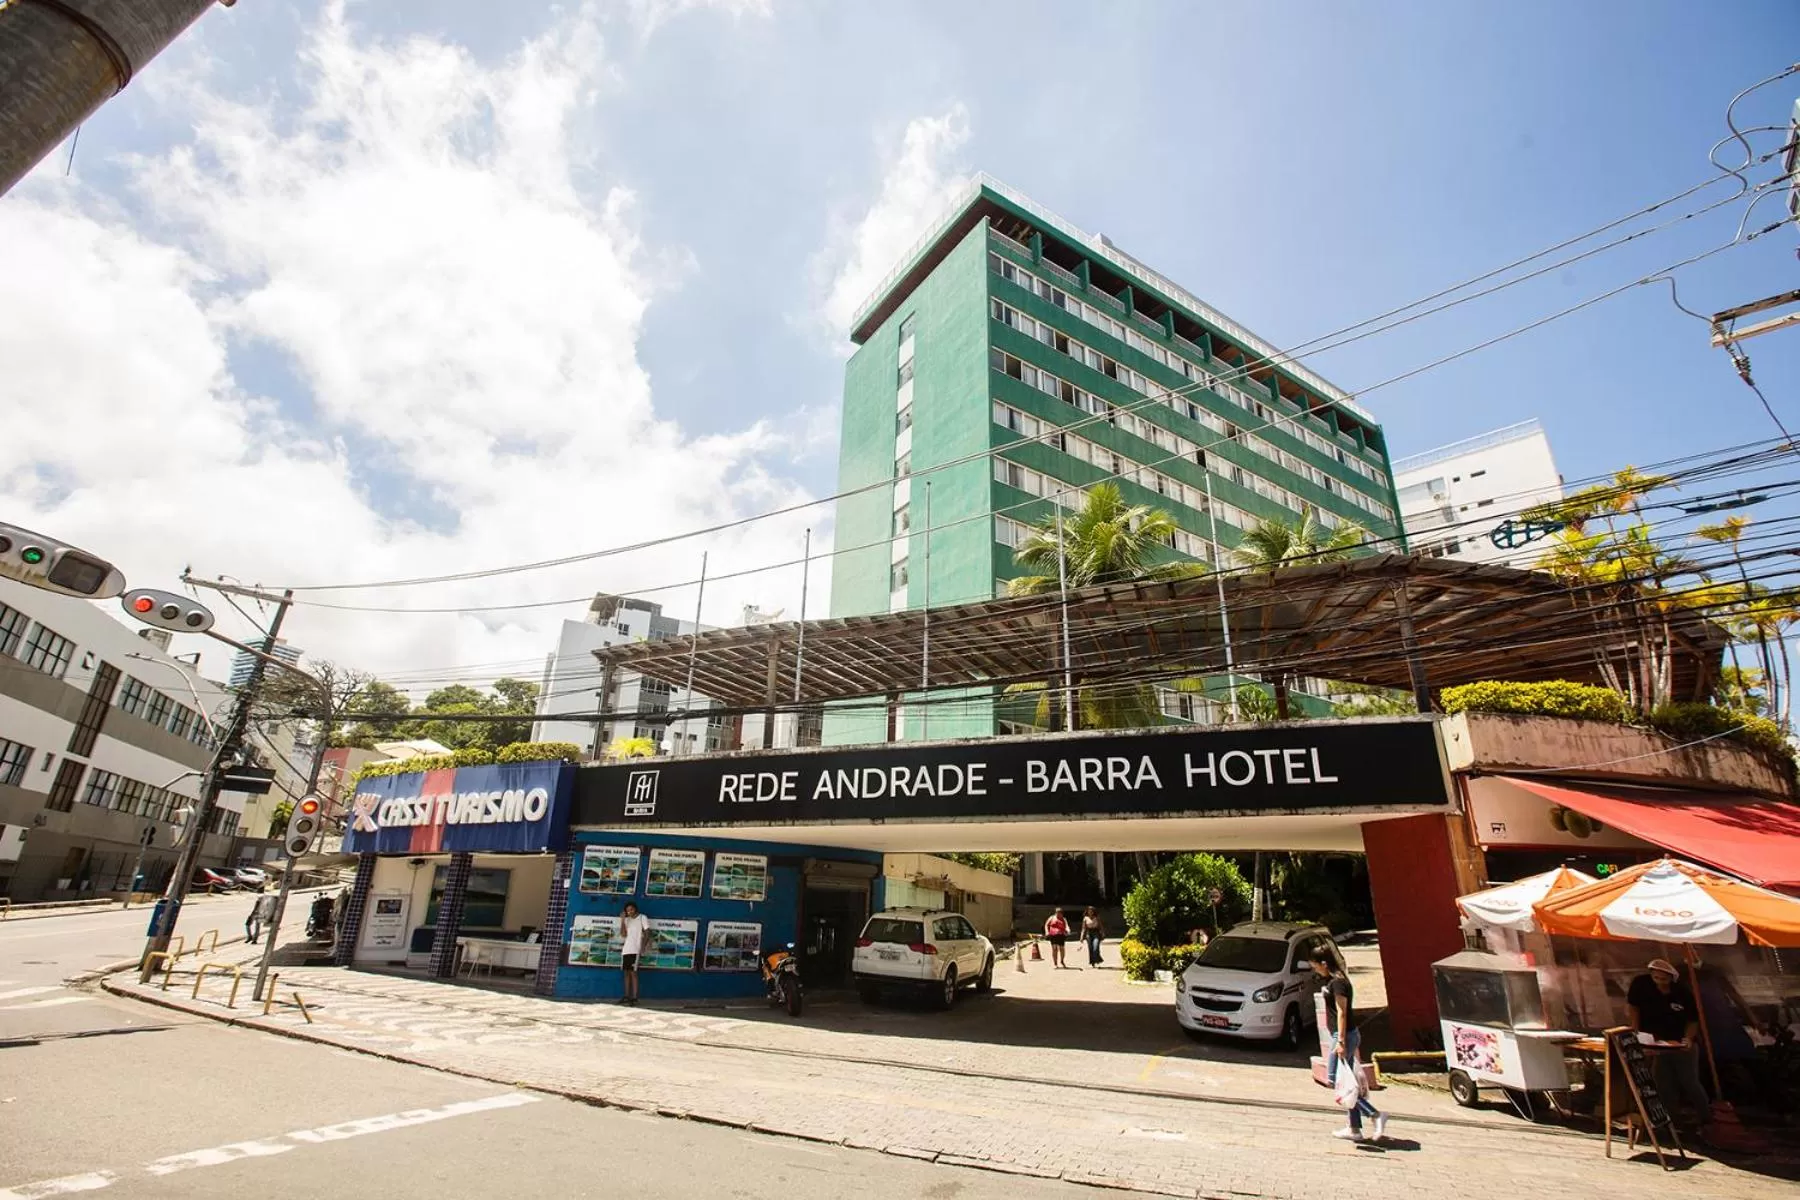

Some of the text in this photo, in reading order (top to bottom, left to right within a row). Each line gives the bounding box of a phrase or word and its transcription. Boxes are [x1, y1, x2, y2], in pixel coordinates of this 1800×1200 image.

[719, 771, 799, 803] REDE
[812, 763, 987, 800] ANDRADE
[1026, 755, 1163, 793] BARRA
[1184, 747, 1339, 788] HOTEL
[378, 787, 548, 827] CASSI TURISMO
